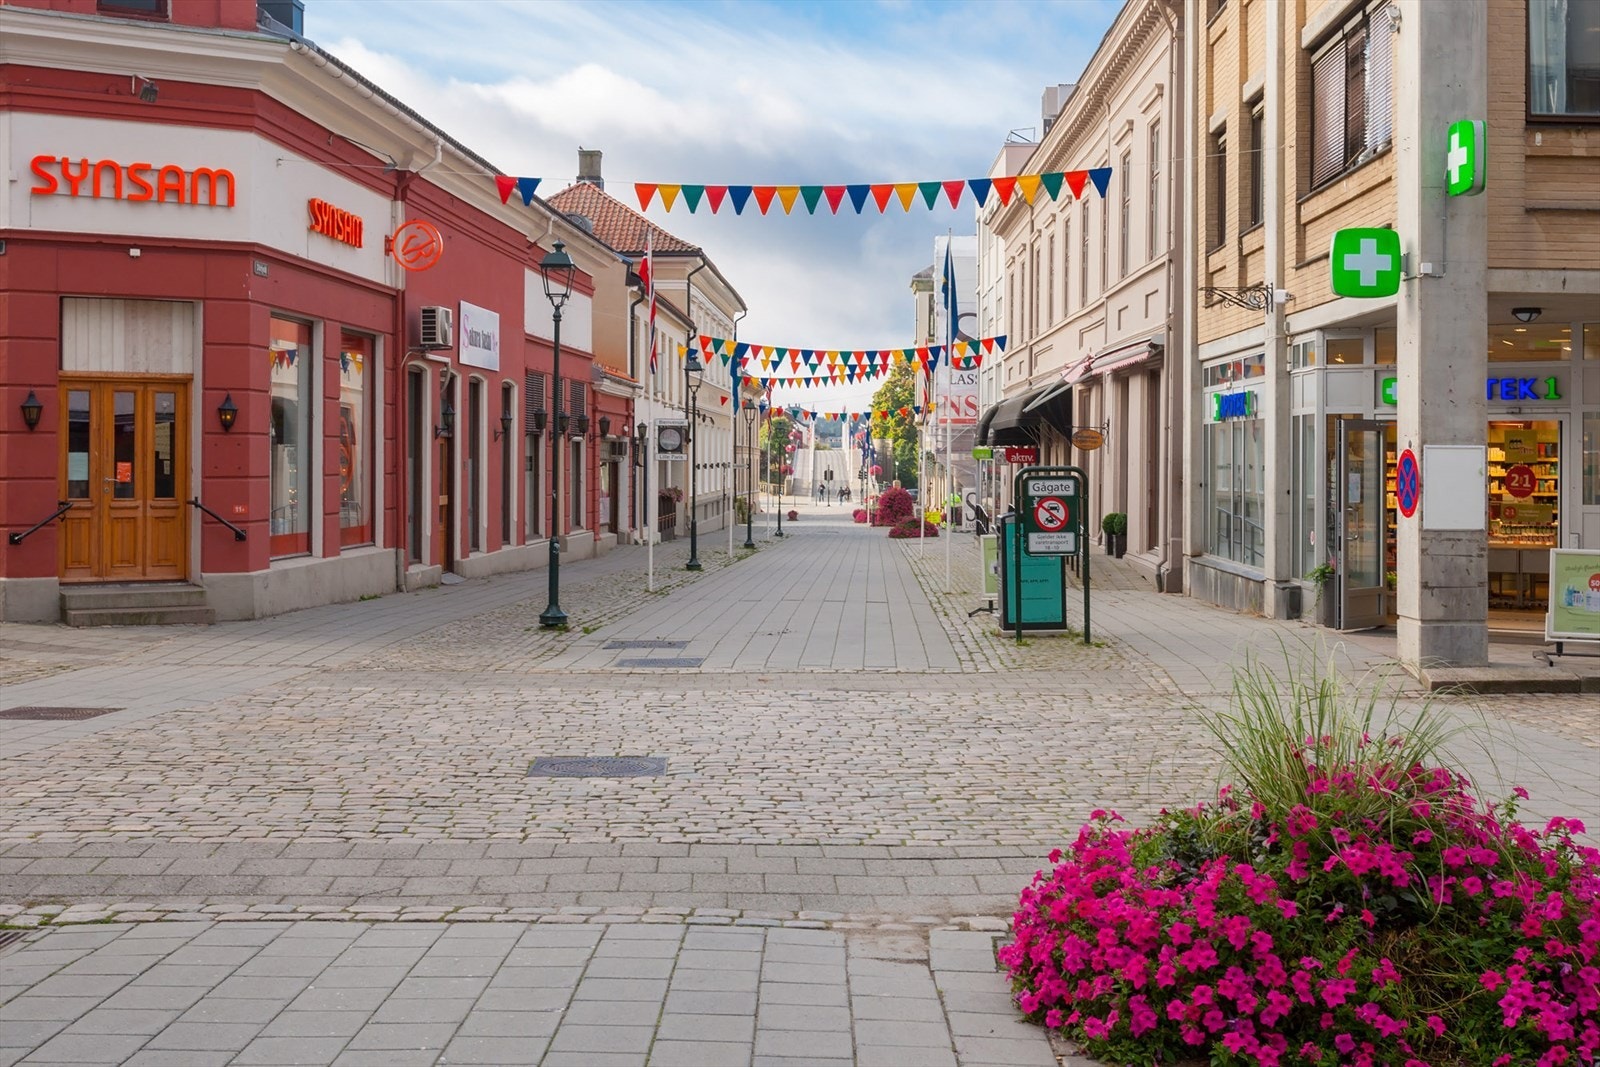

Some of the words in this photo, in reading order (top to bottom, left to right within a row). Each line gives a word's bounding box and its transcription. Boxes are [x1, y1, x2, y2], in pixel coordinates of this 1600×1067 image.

[30, 155, 235, 208] SYNSAM
[307, 197, 363, 248] SYNSAM
[1543, 376, 1561, 400] 1
[1032, 482, 1071, 494] Gågate
